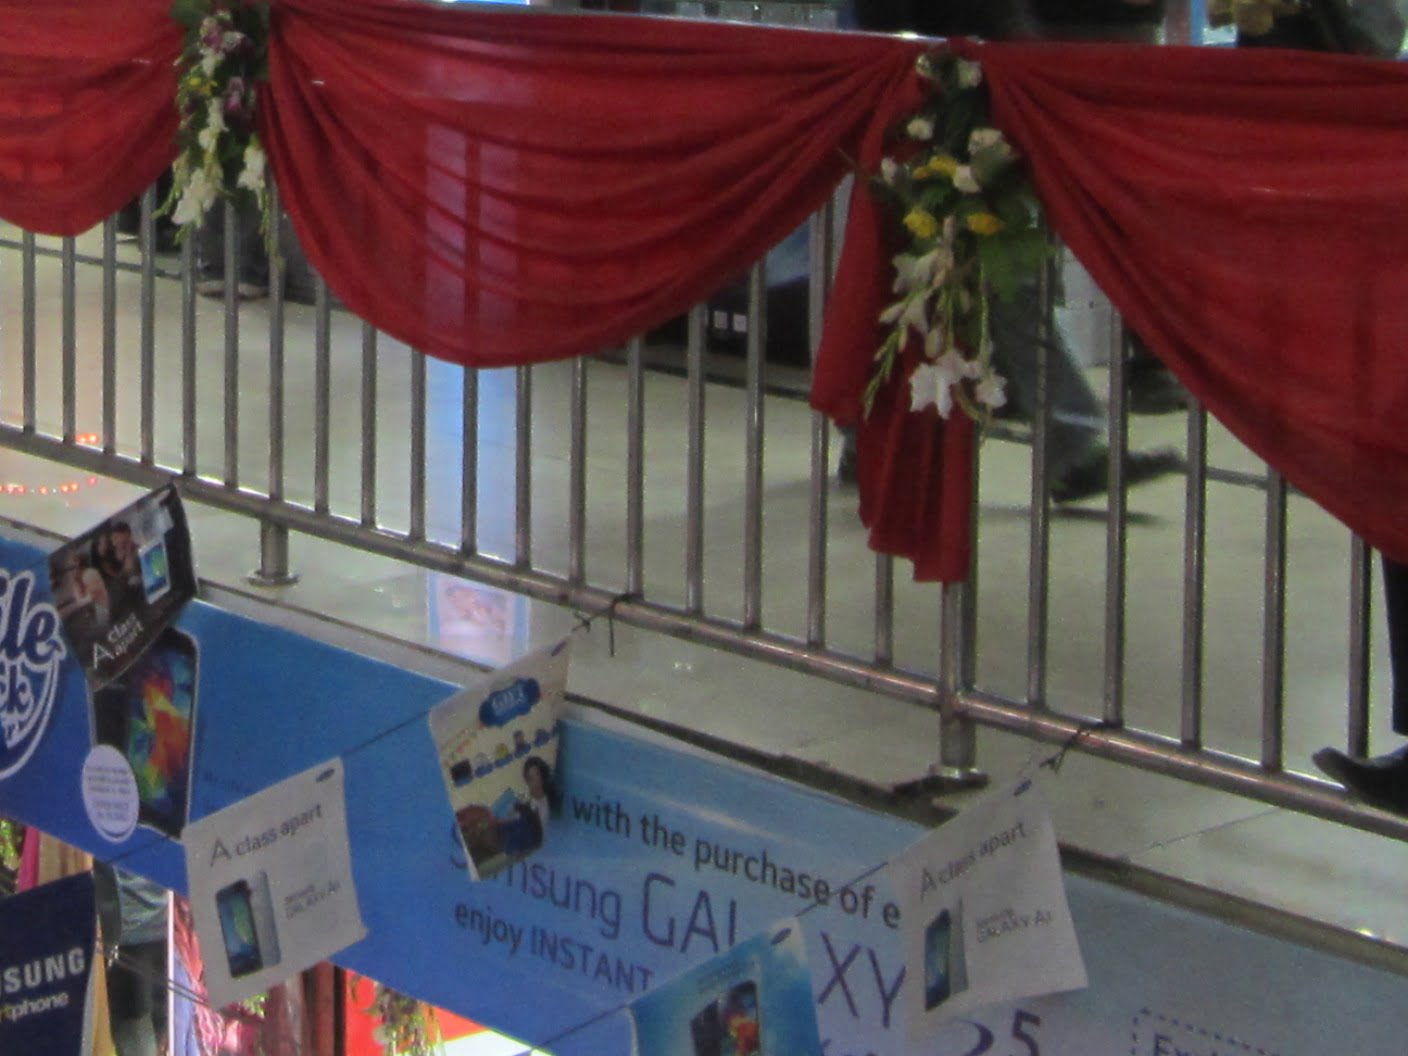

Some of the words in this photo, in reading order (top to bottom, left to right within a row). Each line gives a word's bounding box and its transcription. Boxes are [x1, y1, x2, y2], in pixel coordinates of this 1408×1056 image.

[92, 640, 115, 670] A
[106, 611, 138, 644] class
[208, 839, 233, 868] A
[235, 825, 278, 857] class
[280, 802, 325, 837] apart
[570, 793, 632, 840] with
[640, 814, 687, 856] the
[693, 836, 832, 907] purchase
[838, 882, 875, 920] of
[919, 866, 937, 904] A
[978, 821, 1027, 858] apart
[454, 900, 524, 958] enjoy
[530, 925, 657, 995] INSTANT
[642, 870, 909, 1030] GALXY
